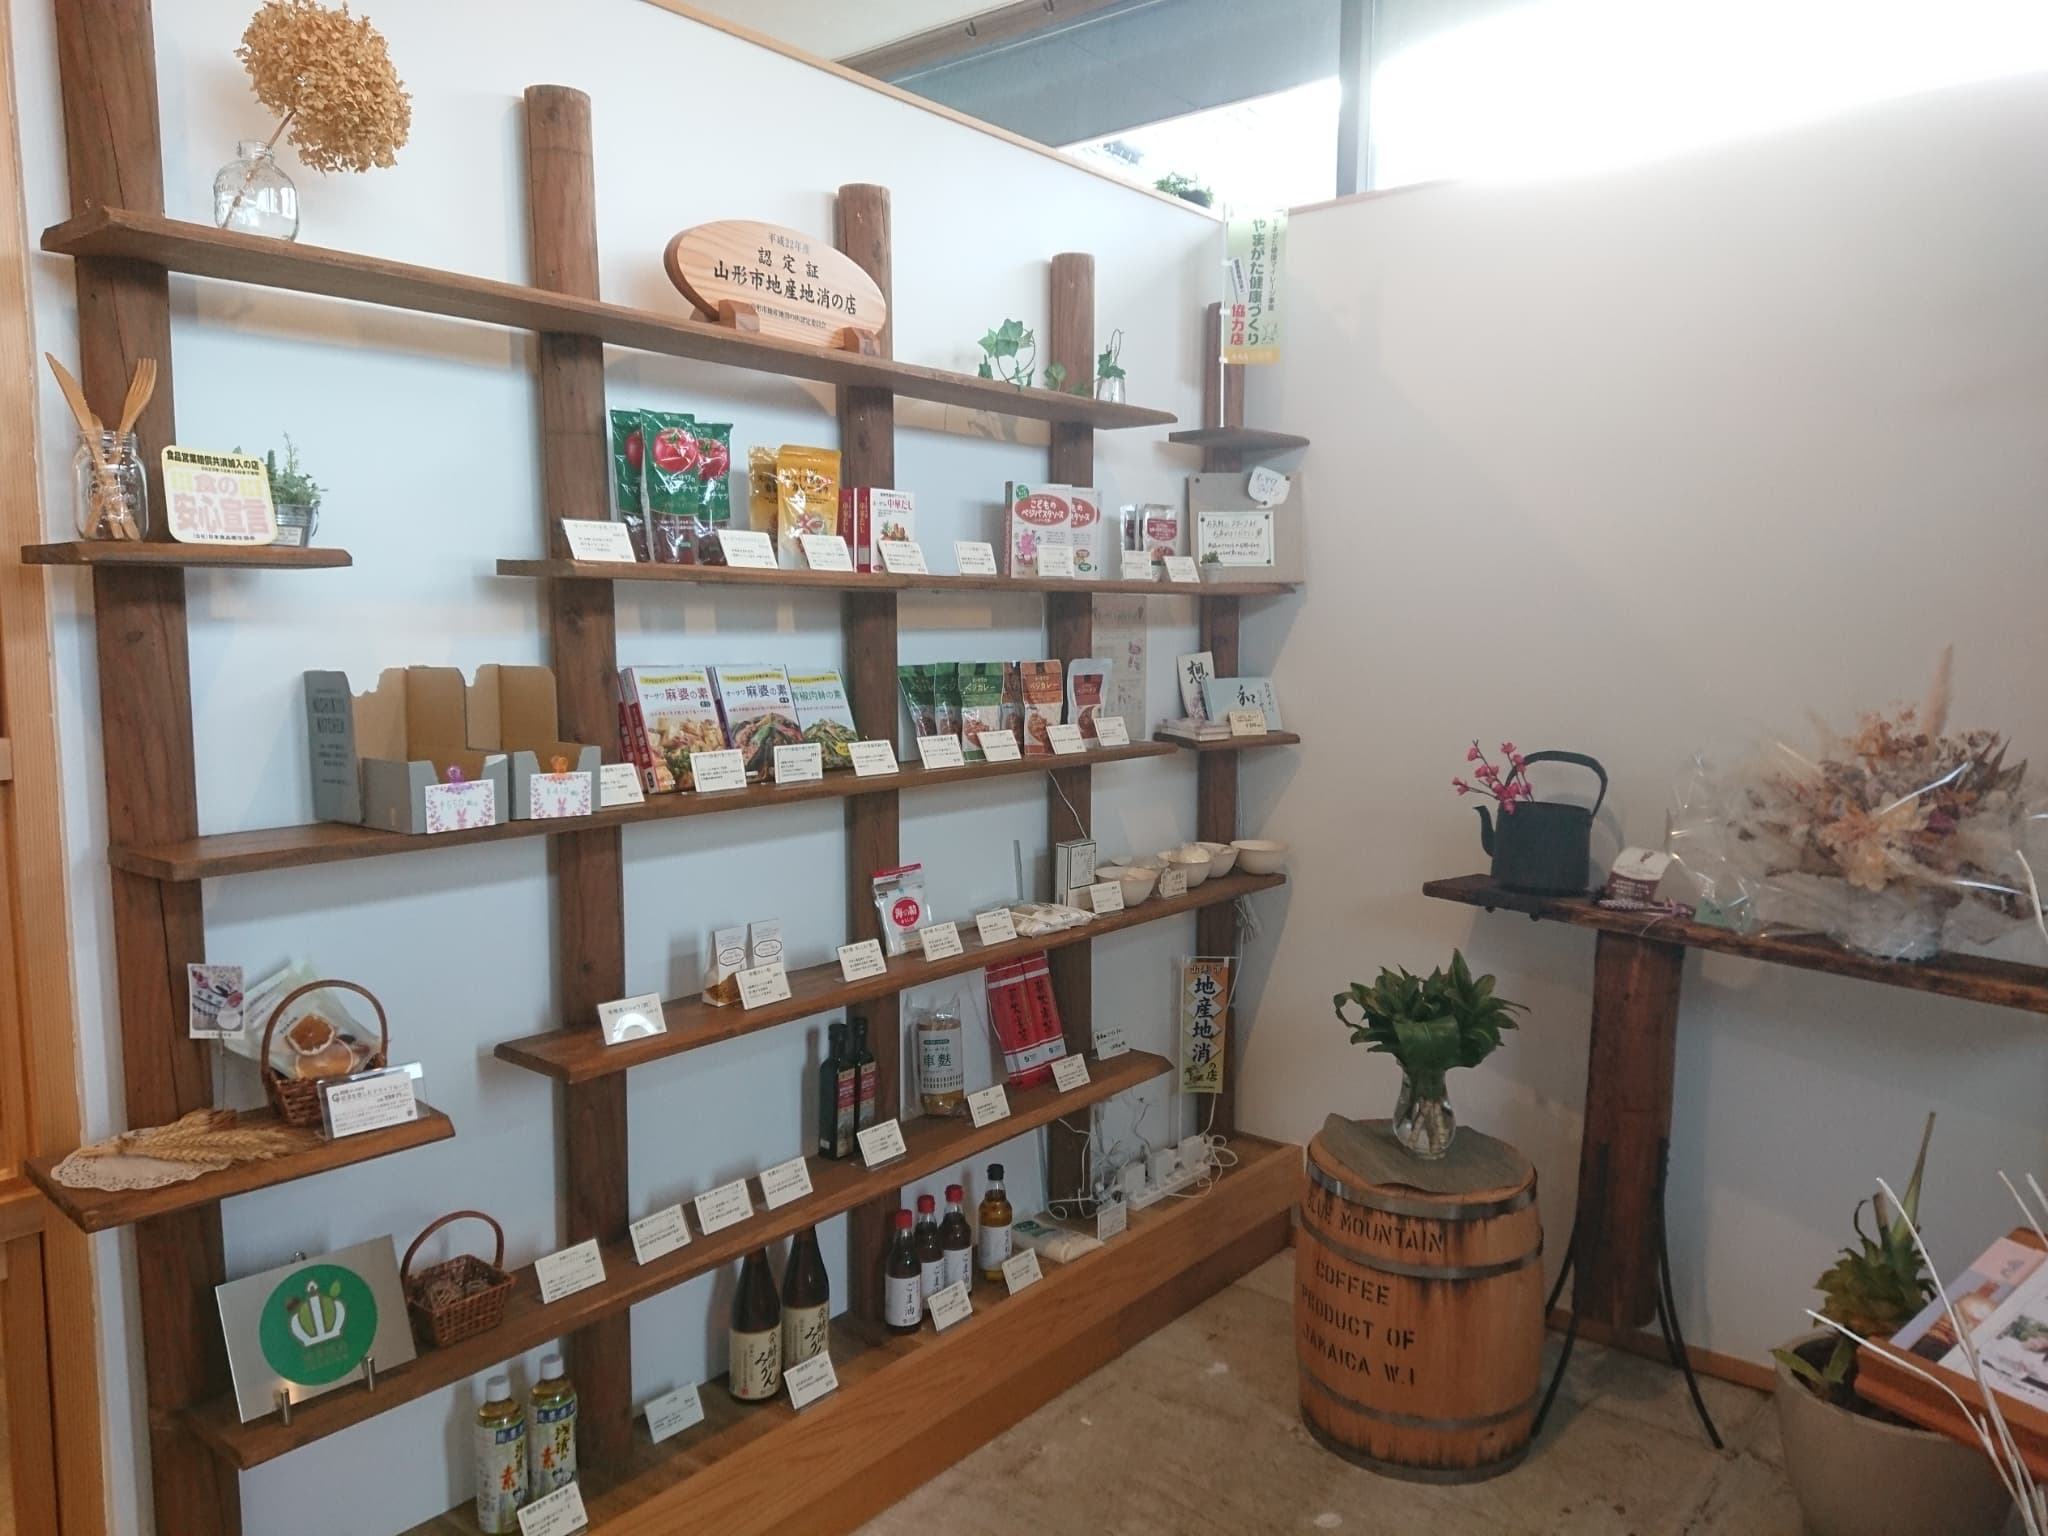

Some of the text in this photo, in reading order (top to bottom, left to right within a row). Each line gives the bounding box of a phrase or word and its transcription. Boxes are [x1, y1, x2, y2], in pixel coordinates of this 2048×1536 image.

[714, 260, 857, 316] 山形市地産地消の店
[1248, 219, 1266, 345] やまがた健康づくり
[1230, 304, 1246, 345] 協力店
[174, 493, 269, 534] 安心宣言
[1021, 509, 1064, 519] ベジパスタソース
[1030, 499, 1057, 510] こどもの
[1192, 975, 1216, 1064] 地産地消
[1340, 1210, 1444, 1254] MOUNTAIN
[1315, 1258, 1391, 1306] COFFEE
[1301, 1284, 1416, 1350] PRODUCT OF
